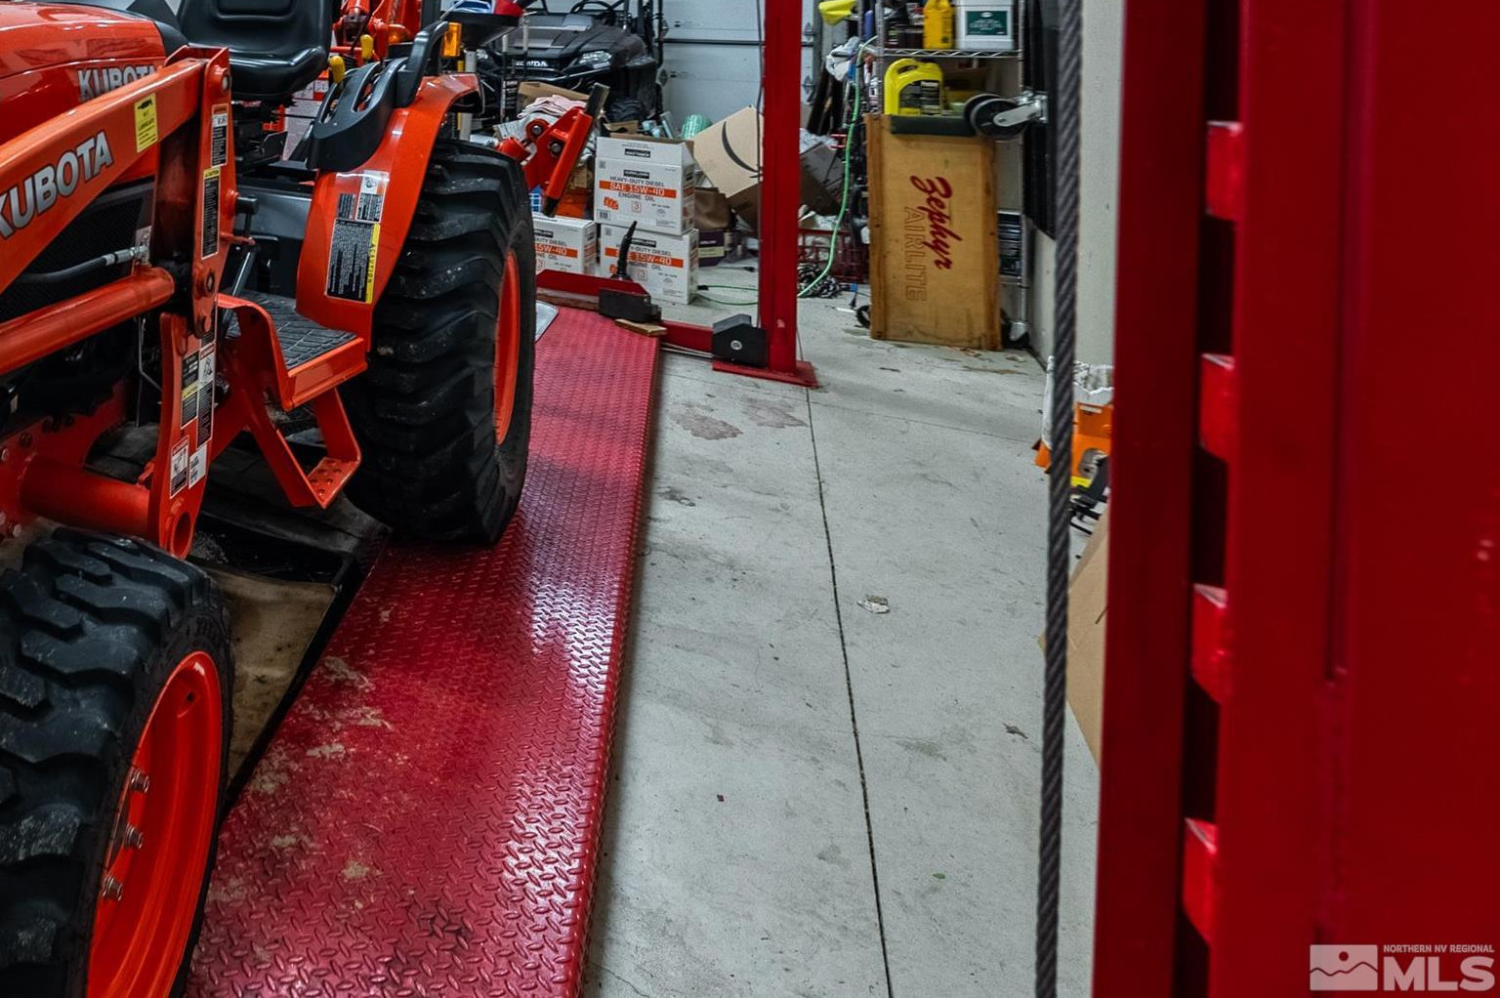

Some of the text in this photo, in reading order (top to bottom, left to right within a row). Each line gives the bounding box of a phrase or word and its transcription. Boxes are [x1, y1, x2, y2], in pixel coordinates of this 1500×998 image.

[609, 181, 665, 196] SAE 15W-40
[610, 176, 664, 188] HEAVY-DUTY DIESEL
[618, 192, 642, 201] ENGINE
[636, 251, 671, 265] 15W-40
[652, 247, 671, 256] DIESEL
[904, 205, 927, 302] AIRLITE
